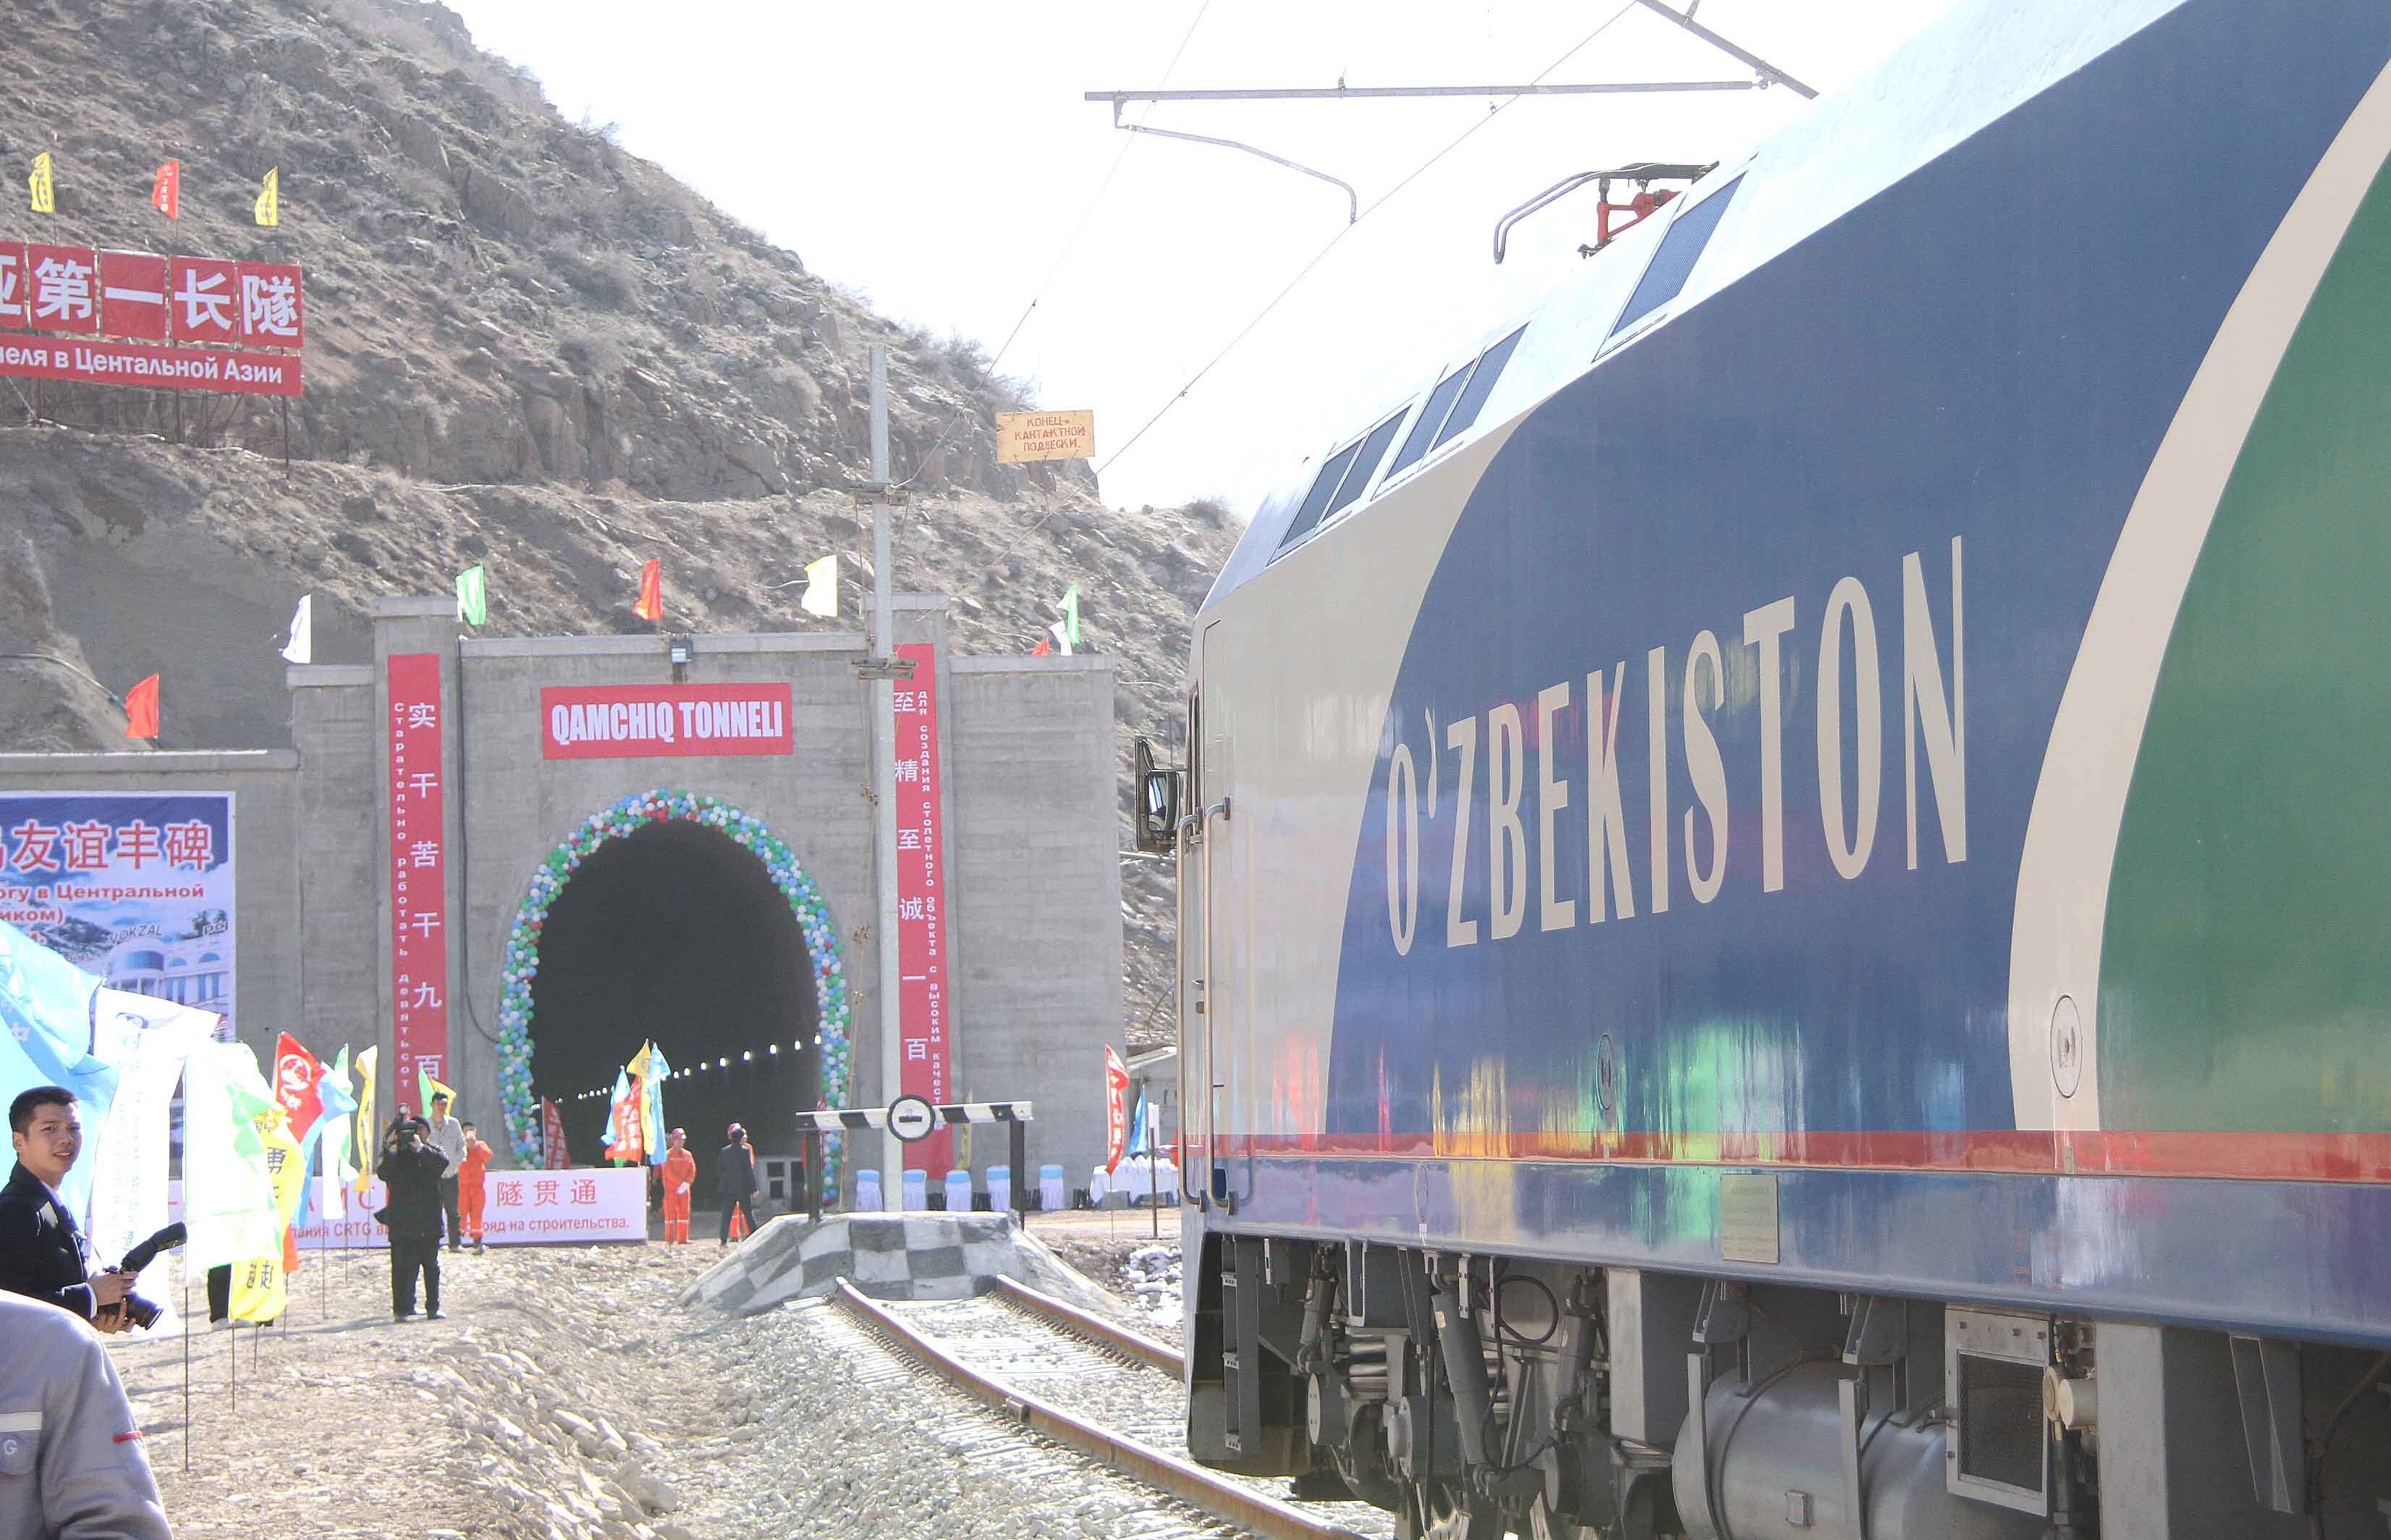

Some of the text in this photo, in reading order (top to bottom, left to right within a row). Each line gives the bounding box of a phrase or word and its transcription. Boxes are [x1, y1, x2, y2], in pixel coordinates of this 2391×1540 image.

[54, 350, 69, 368] в
[75, 347, 218, 379] Центальной
[224, 358, 282, 383] Азии
[1015, 424, 1086, 441] КАНТАКТНОЙ
[551, 701, 783, 745] QAMCHIQ TONNELI
[918, 690, 928, 716] для
[394, 703, 406, 839] Старательно
[920, 725, 931, 792] создания
[0, 821, 211, 869] 友谊丰碑
[923, 801, 935, 887] столетного
[38, 889, 48, 898] в
[57, 884, 204, 902] Центральной
[397, 857, 409, 956] работать
[109, 925, 162, 944] VOKZAL
[926, 896, 937, 956] объекта
[928, 983, 941, 1043] высоким
[334, 1222, 371, 1236] CRTG
[509, 1221, 525, 1231] на
